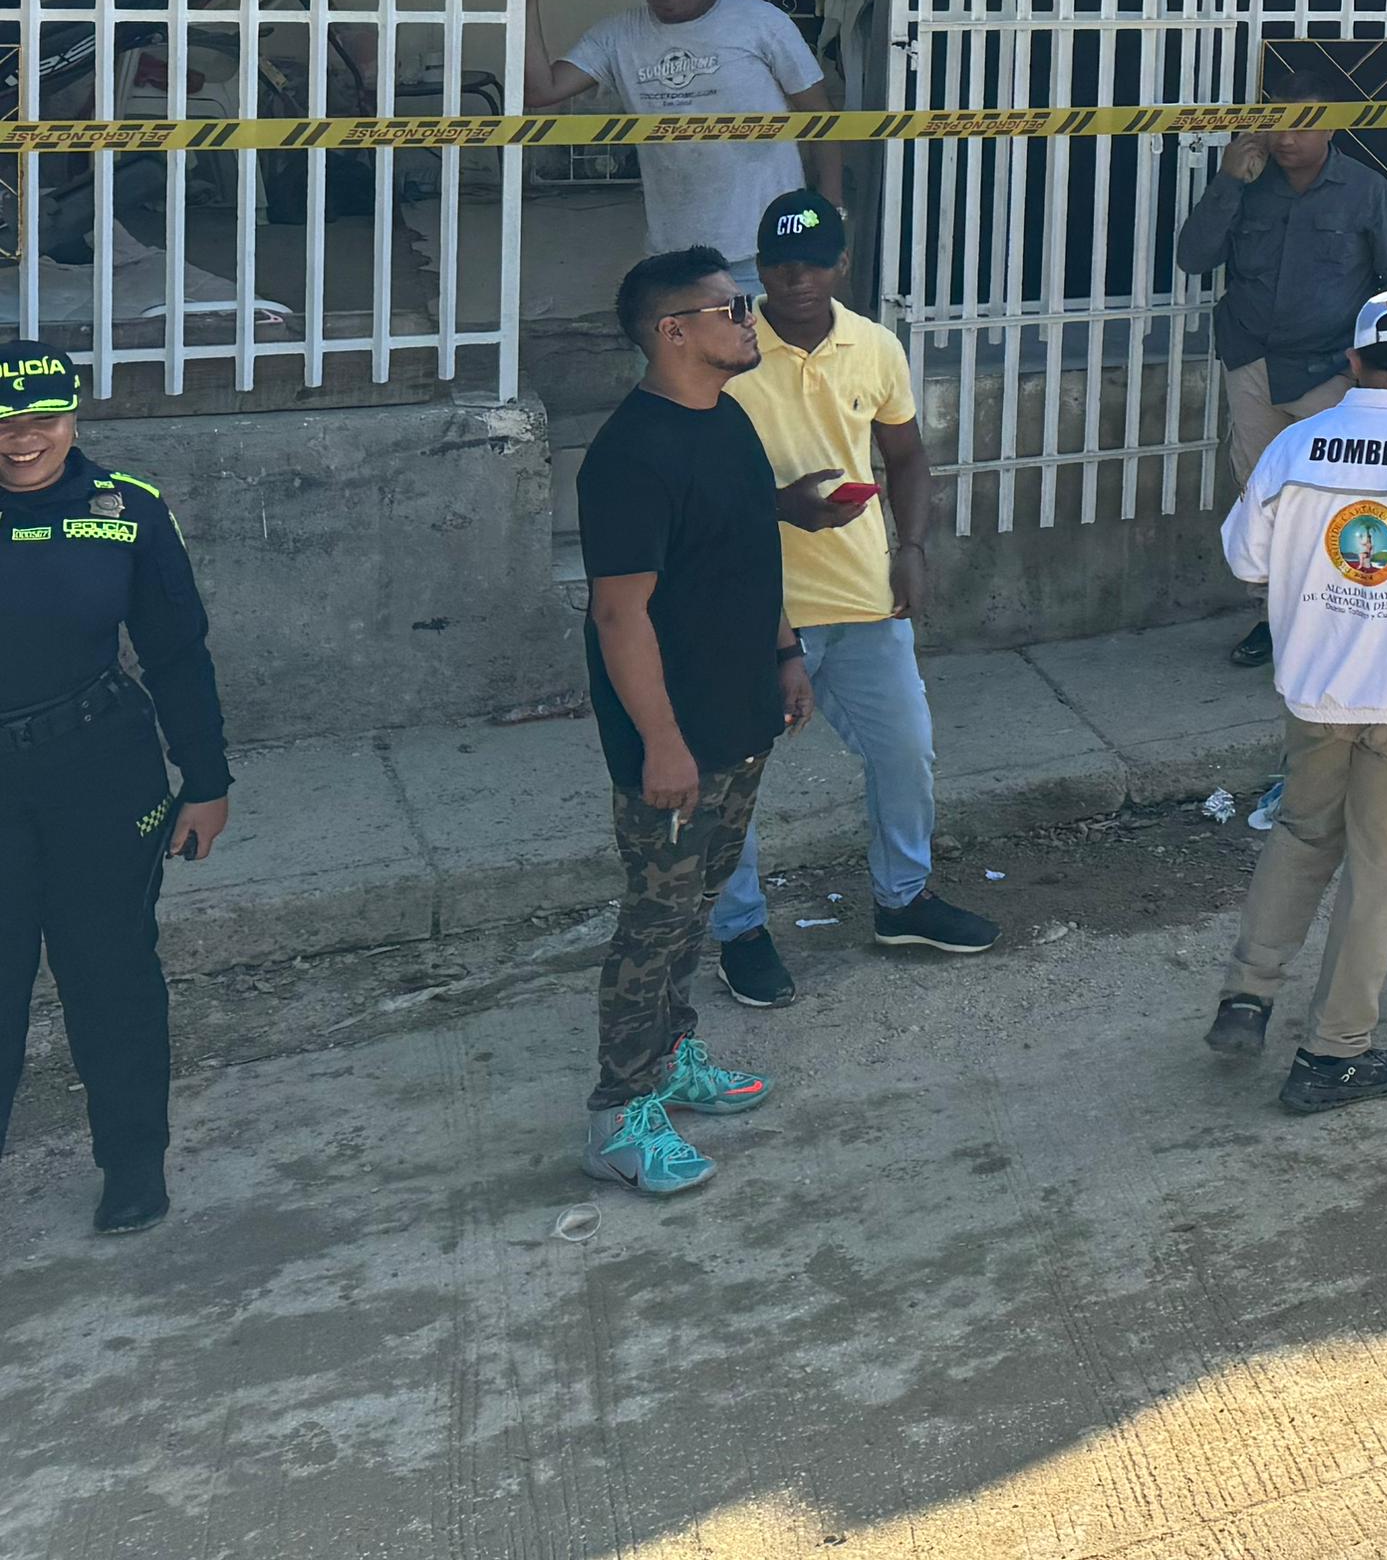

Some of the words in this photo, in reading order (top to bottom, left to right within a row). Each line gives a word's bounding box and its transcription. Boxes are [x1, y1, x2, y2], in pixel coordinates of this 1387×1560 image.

[986, 120, 1047, 130] PELIGRO
[1172, 116, 1205, 126] PASE
[1207, 115, 1228, 125] NO
[1228, 115, 1282, 125] PELIGRO
[652, 125, 691, 135] PASE
[693, 125, 716, 134] NO
[718, 124, 785, 134] PELIGRO
[924, 121, 961, 131] PASE
[962, 121, 984, 130] NO
[6, 132, 51, 142] PASE
[57, 131, 85, 141] NO
[89, 131, 171, 142] PELIGRO
[346, 129, 390, 138] PASE
[393, 128, 418, 138] NO
[421, 128, 494, 137] PELIGRO
[1303, 594, 1318, 602] DE
[1373, 602, 1387, 611] DE
